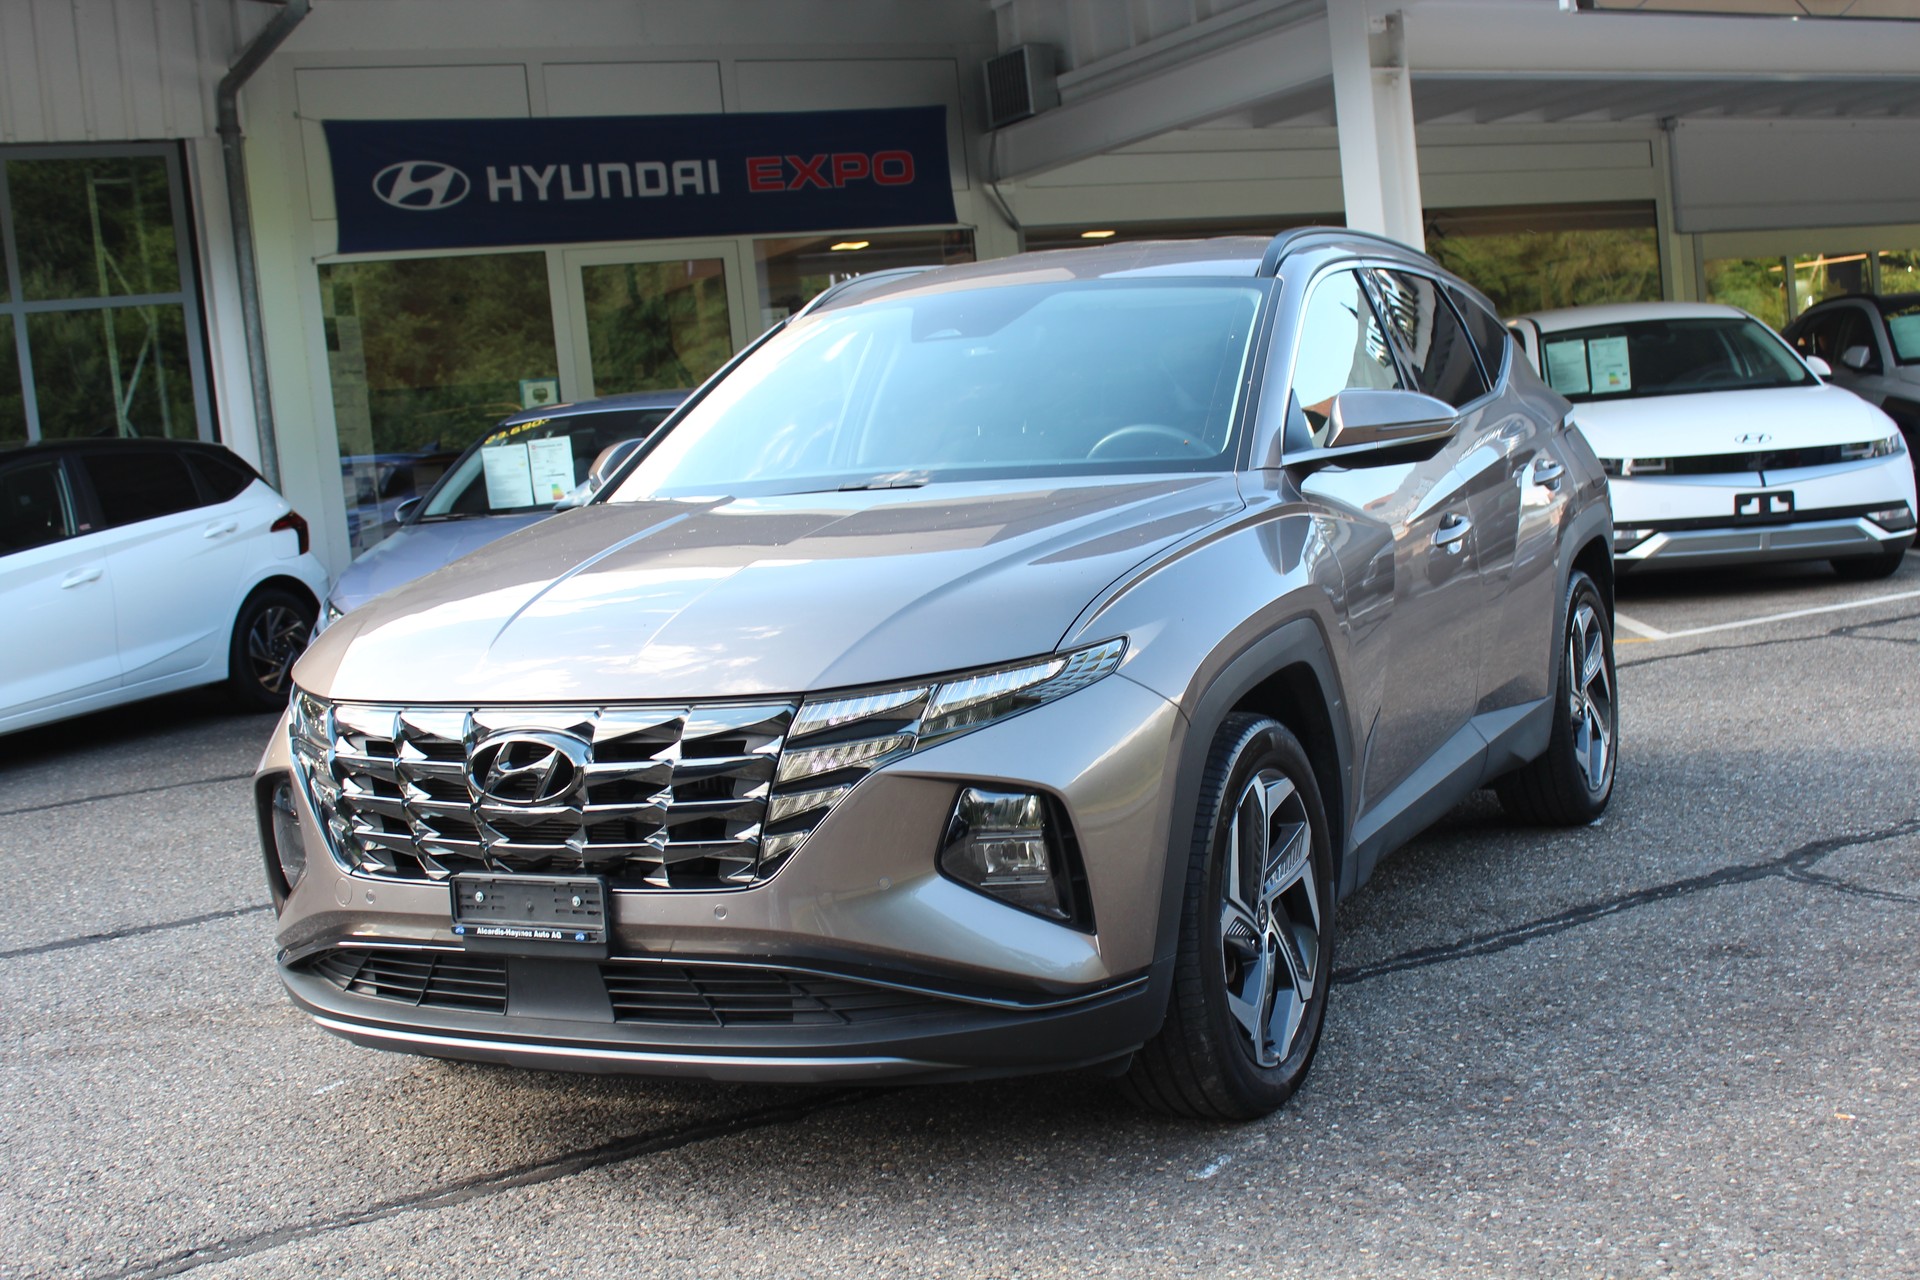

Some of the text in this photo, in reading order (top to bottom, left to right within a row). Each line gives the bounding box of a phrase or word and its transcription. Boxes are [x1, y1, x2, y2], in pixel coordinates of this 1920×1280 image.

[486, 150, 915, 202] HYUNDAI EXPO
[533, 930, 550, 939] Auto
[551, 931, 562, 939] AG
